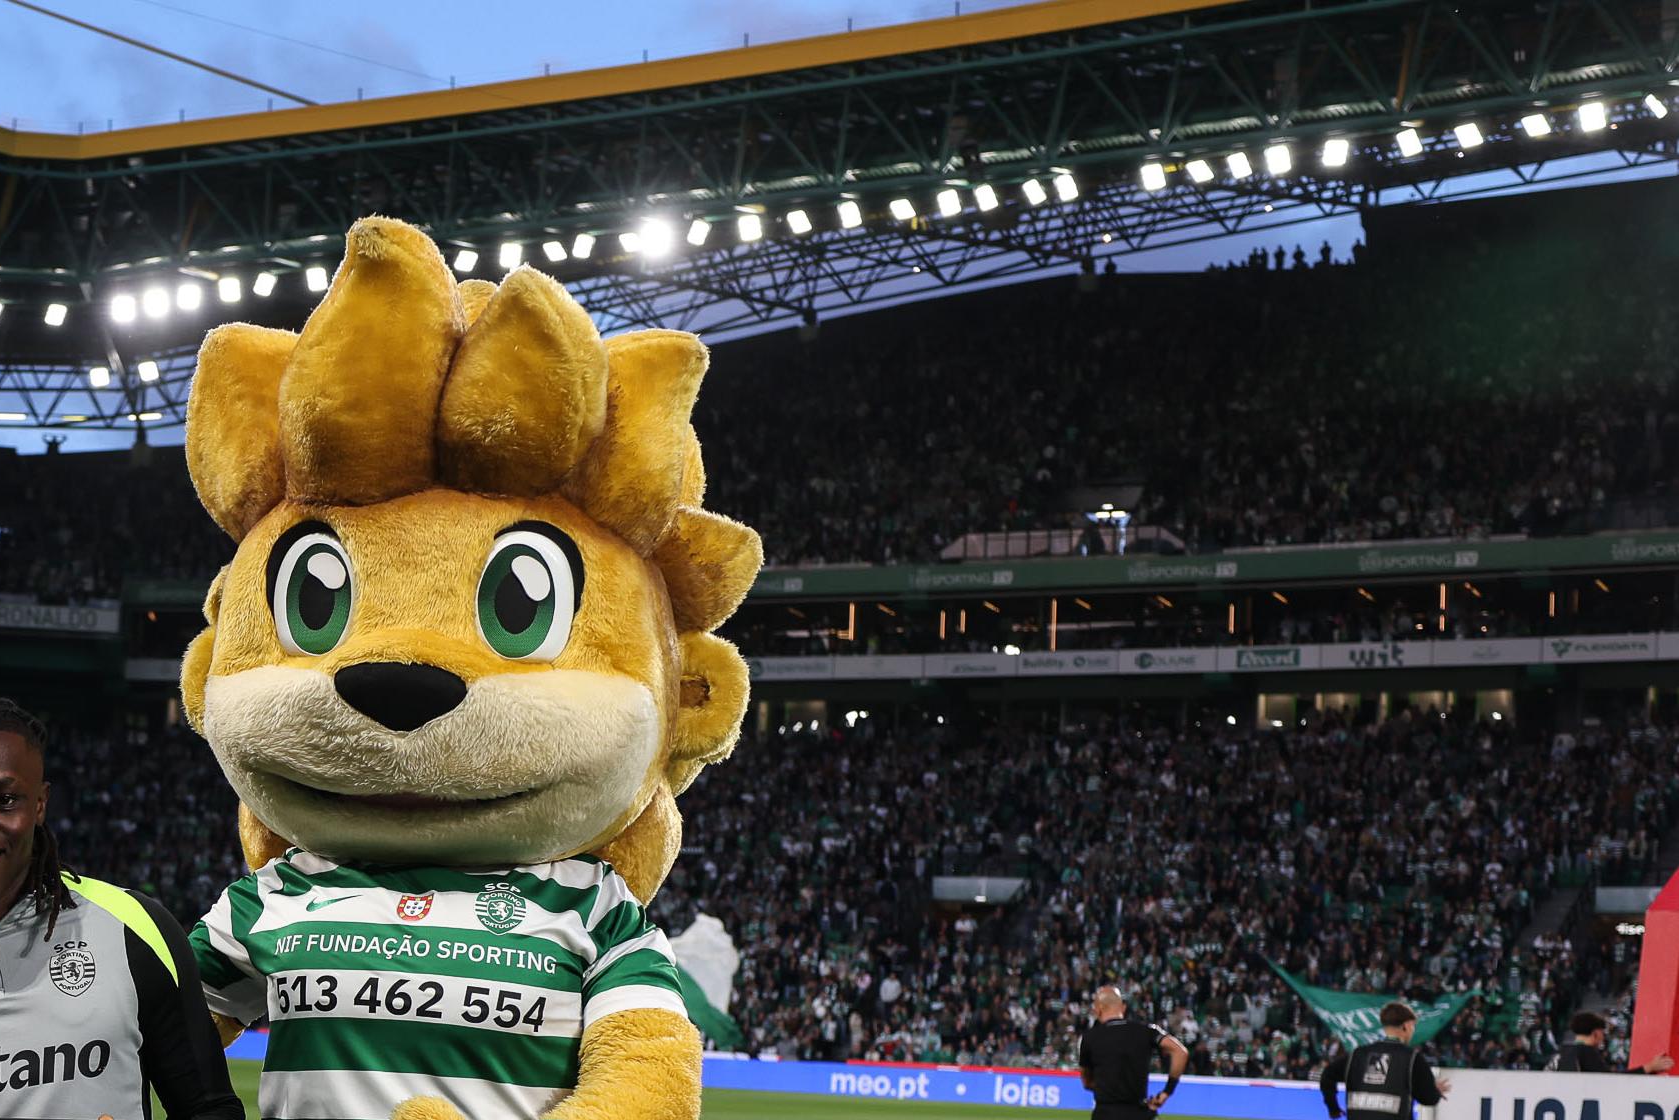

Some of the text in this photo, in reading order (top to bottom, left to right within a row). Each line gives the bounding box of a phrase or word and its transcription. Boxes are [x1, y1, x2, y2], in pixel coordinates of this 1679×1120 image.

[484, 882, 521, 893] SCP
[480, 893, 522, 906] SPORTING
[480, 918, 518, 929] PORTUGAL
[54, 941, 87, 953] SCP
[54, 952, 89, 965] SPORTING
[274, 934, 557, 975] NIF FUNDAÇÃO SPORTING
[59, 980, 91, 991] PORTUGAL
[276, 975, 547, 1033] 513 462 554
[830, 1072, 1060, 1106] meo.pt lojas
